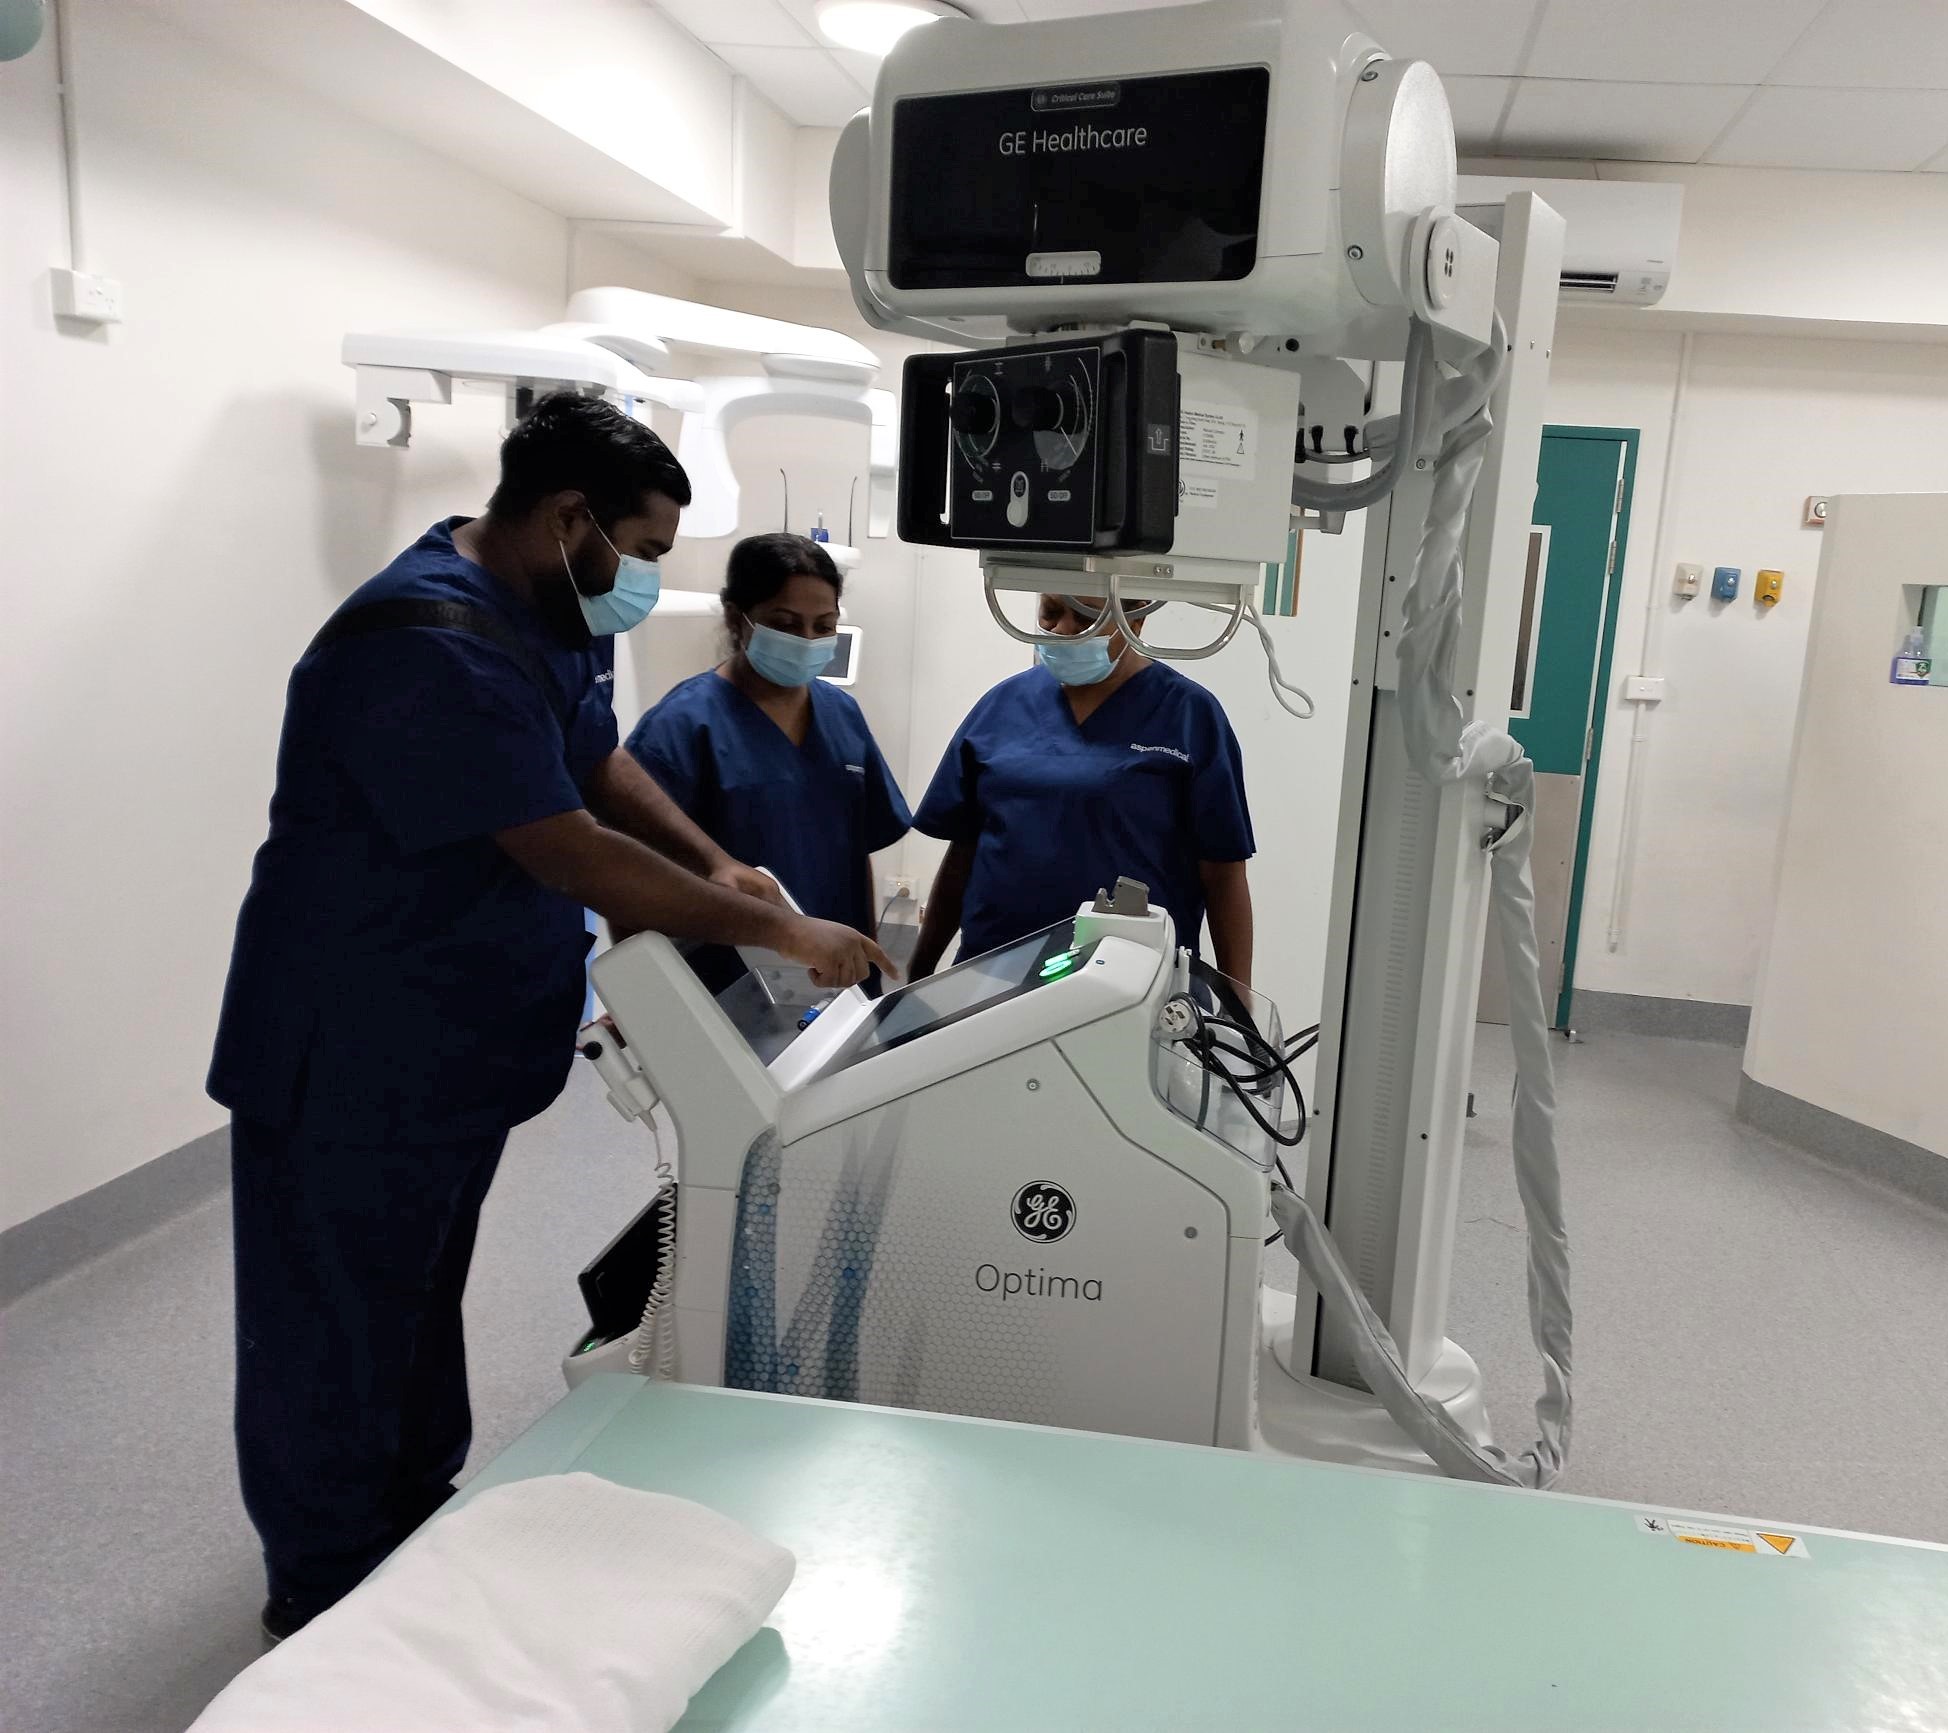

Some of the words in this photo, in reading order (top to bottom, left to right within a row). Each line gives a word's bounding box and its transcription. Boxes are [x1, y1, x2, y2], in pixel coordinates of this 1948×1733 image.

[1051, 92, 1078, 103] Critical
[1078, 91, 1095, 101] Care
[1096, 89, 1116, 99] Suite
[999, 131, 1026, 156] GE
[1033, 125, 1147, 152] Healthcare
[1130, 743, 1190, 762] aspenmedical
[975, 1263, 1103, 1302] Optima
